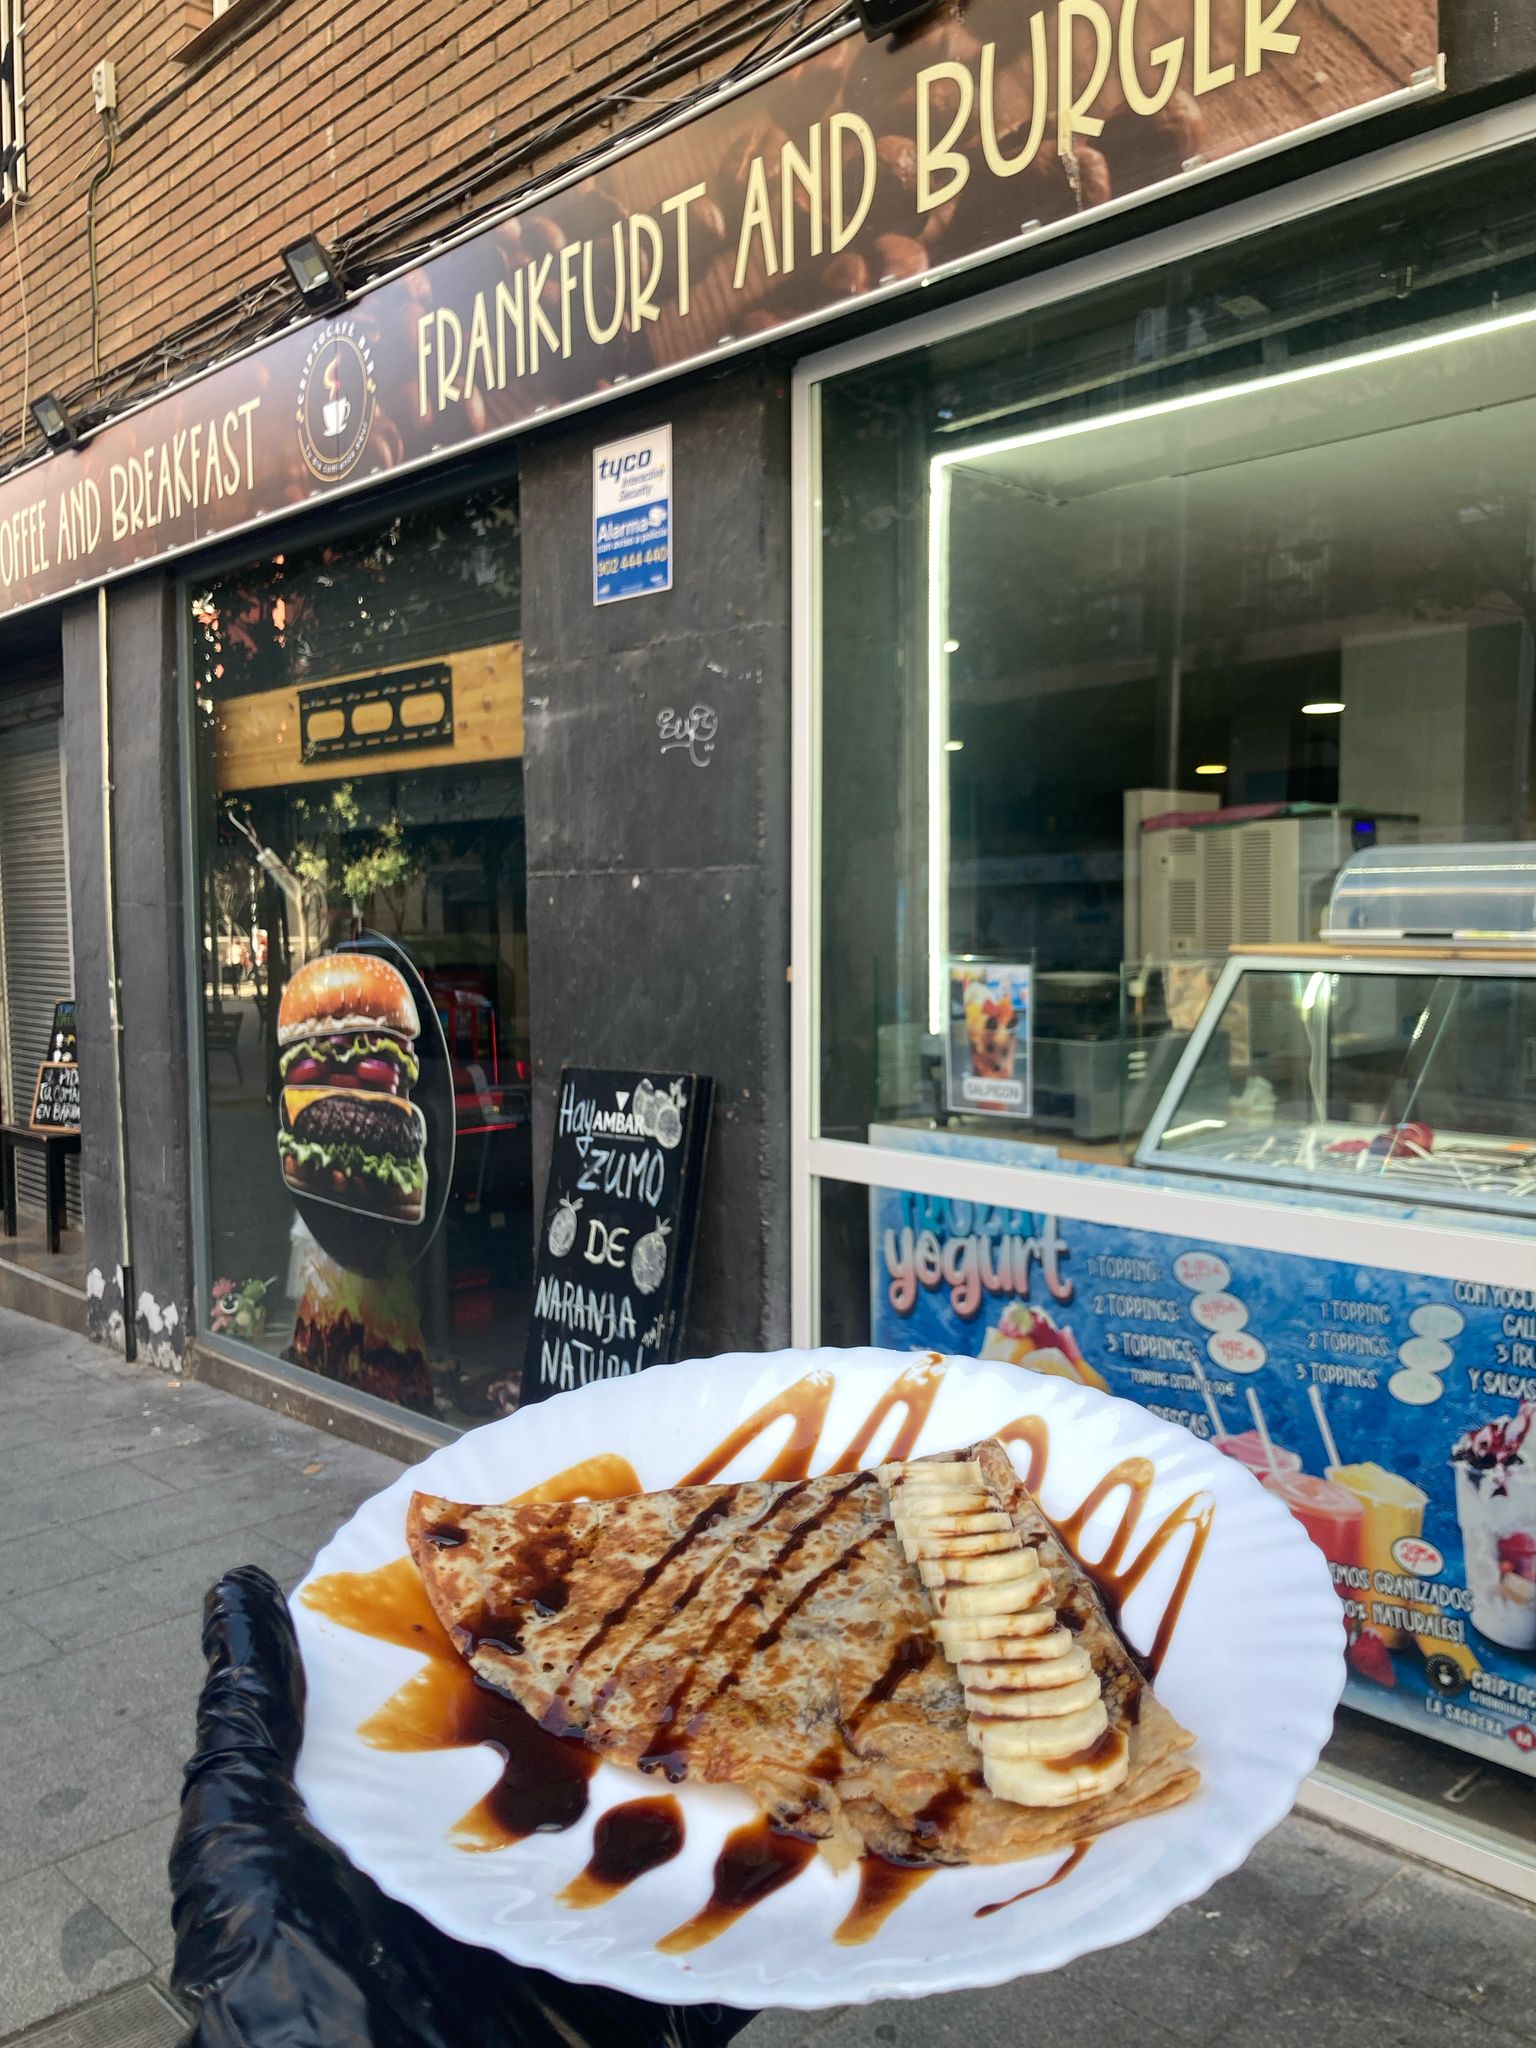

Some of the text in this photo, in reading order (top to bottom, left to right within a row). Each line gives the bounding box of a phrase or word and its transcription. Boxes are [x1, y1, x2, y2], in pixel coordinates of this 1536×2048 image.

[417, 184, 708, 417] FRANKFURT
[733, 111, 878, 290] AND
[599, 449, 652, 483] tyco
[57, 478, 101, 566] AND
[110, 396, 262, 543] BREAKFAST
[620, 550, 642, 570] 444
[559, 1081, 596, 1157] Hay
[592, 1110, 646, 1136] AMBAR
[577, 1148, 665, 1208] ZUMO
[583, 1219, 630, 1269] DE
[885, 1215, 1074, 1317] yogurt
[1094, 1295, 1104, 1315] 2
[1455, 1281, 1488, 1306] CON
[534, 1273, 637, 1344] NARANJA
[1321, 1300, 1391, 1324] 1 TOPPING
[1106, 1333, 1119, 1352] 3
[1308, 1331, 1318, 1350] 2
[1320, 1330, 1390, 1357] TOPPINGS
[1496, 1343, 1510, 1364] 3
[1296, 1363, 1307, 1380] 3
[1309, 1361, 1379, 1390] TOPPINGS
[1468, 1367, 1480, 1392] Y
[1373, 1570, 1473, 1613] GRANIZADOS
[1425, 1696, 1443, 1714] LA
